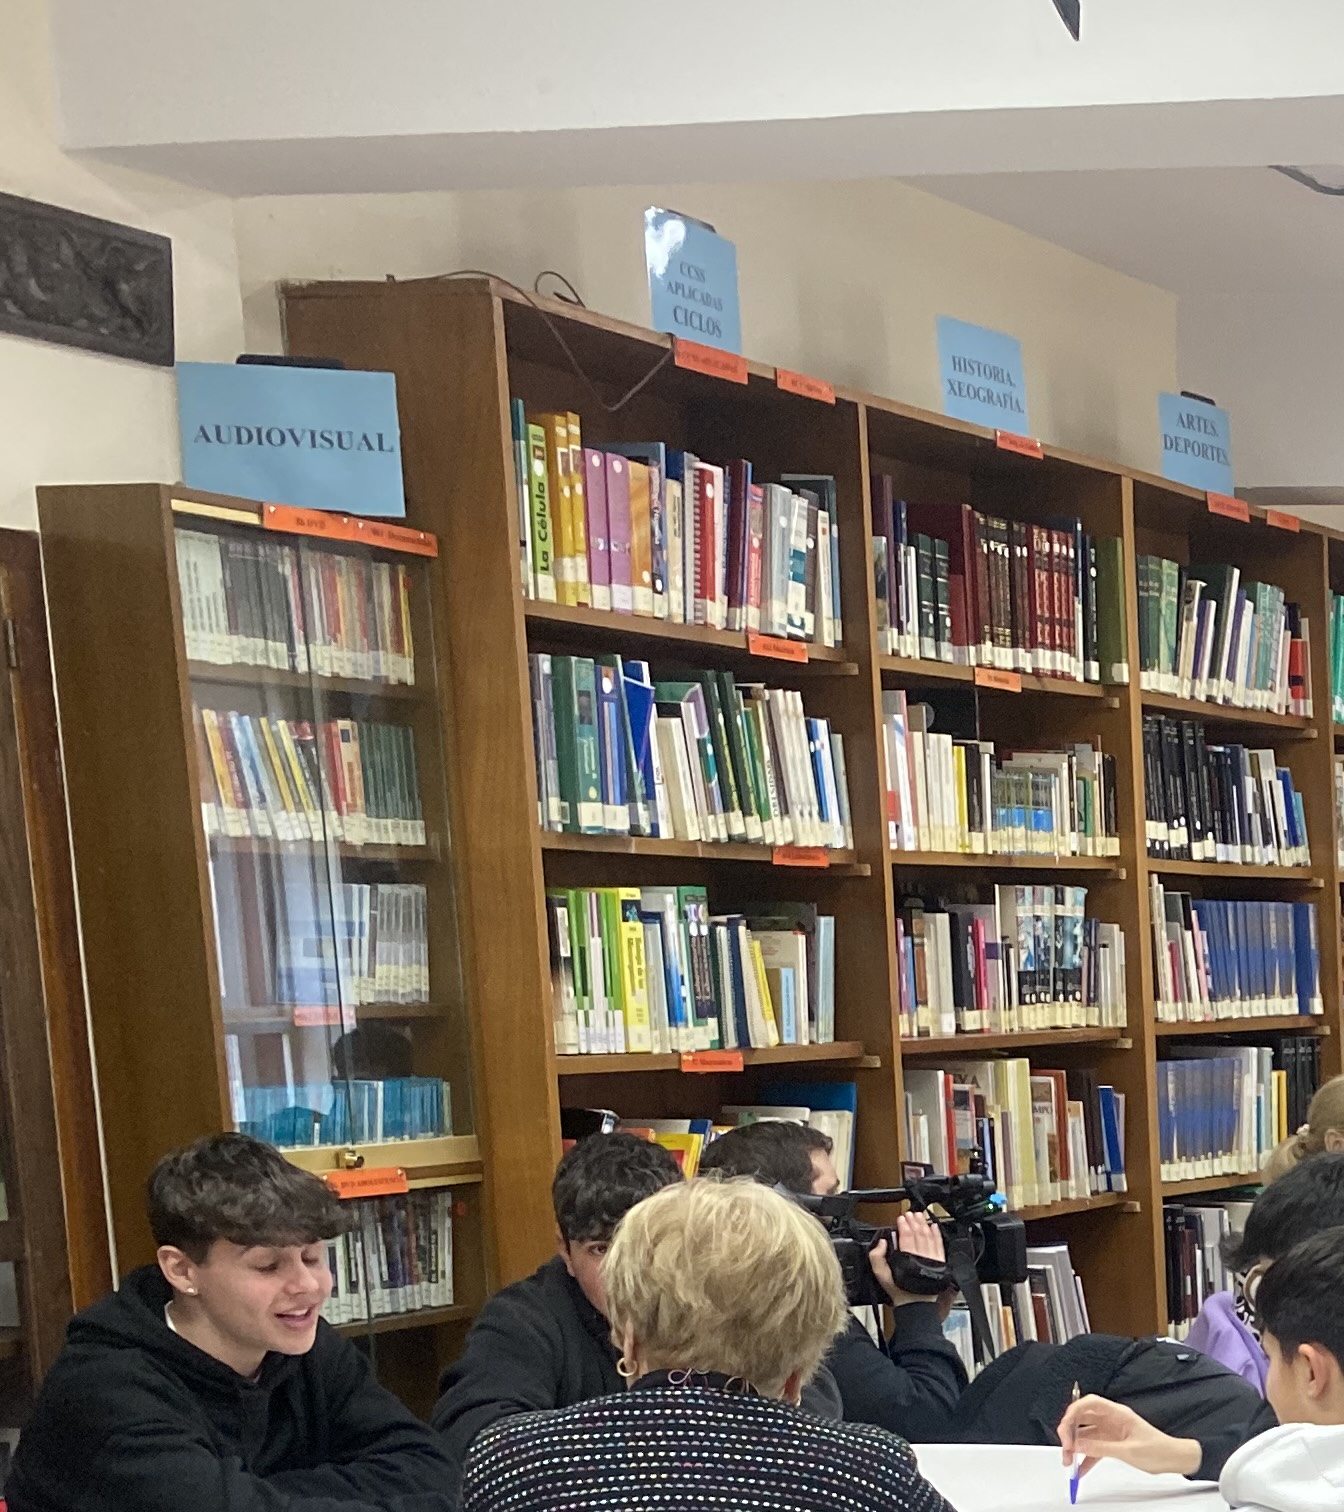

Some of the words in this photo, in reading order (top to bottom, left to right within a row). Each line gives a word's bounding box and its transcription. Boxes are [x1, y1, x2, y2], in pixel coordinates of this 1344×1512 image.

[666, 281, 724, 312] APLICADAS
[673, 304, 723, 339] CICLOS
[194, 424, 395, 453] AUDIOVISUAL
[535, 481, 548, 542] Célula
[540, 550, 549, 571] La
